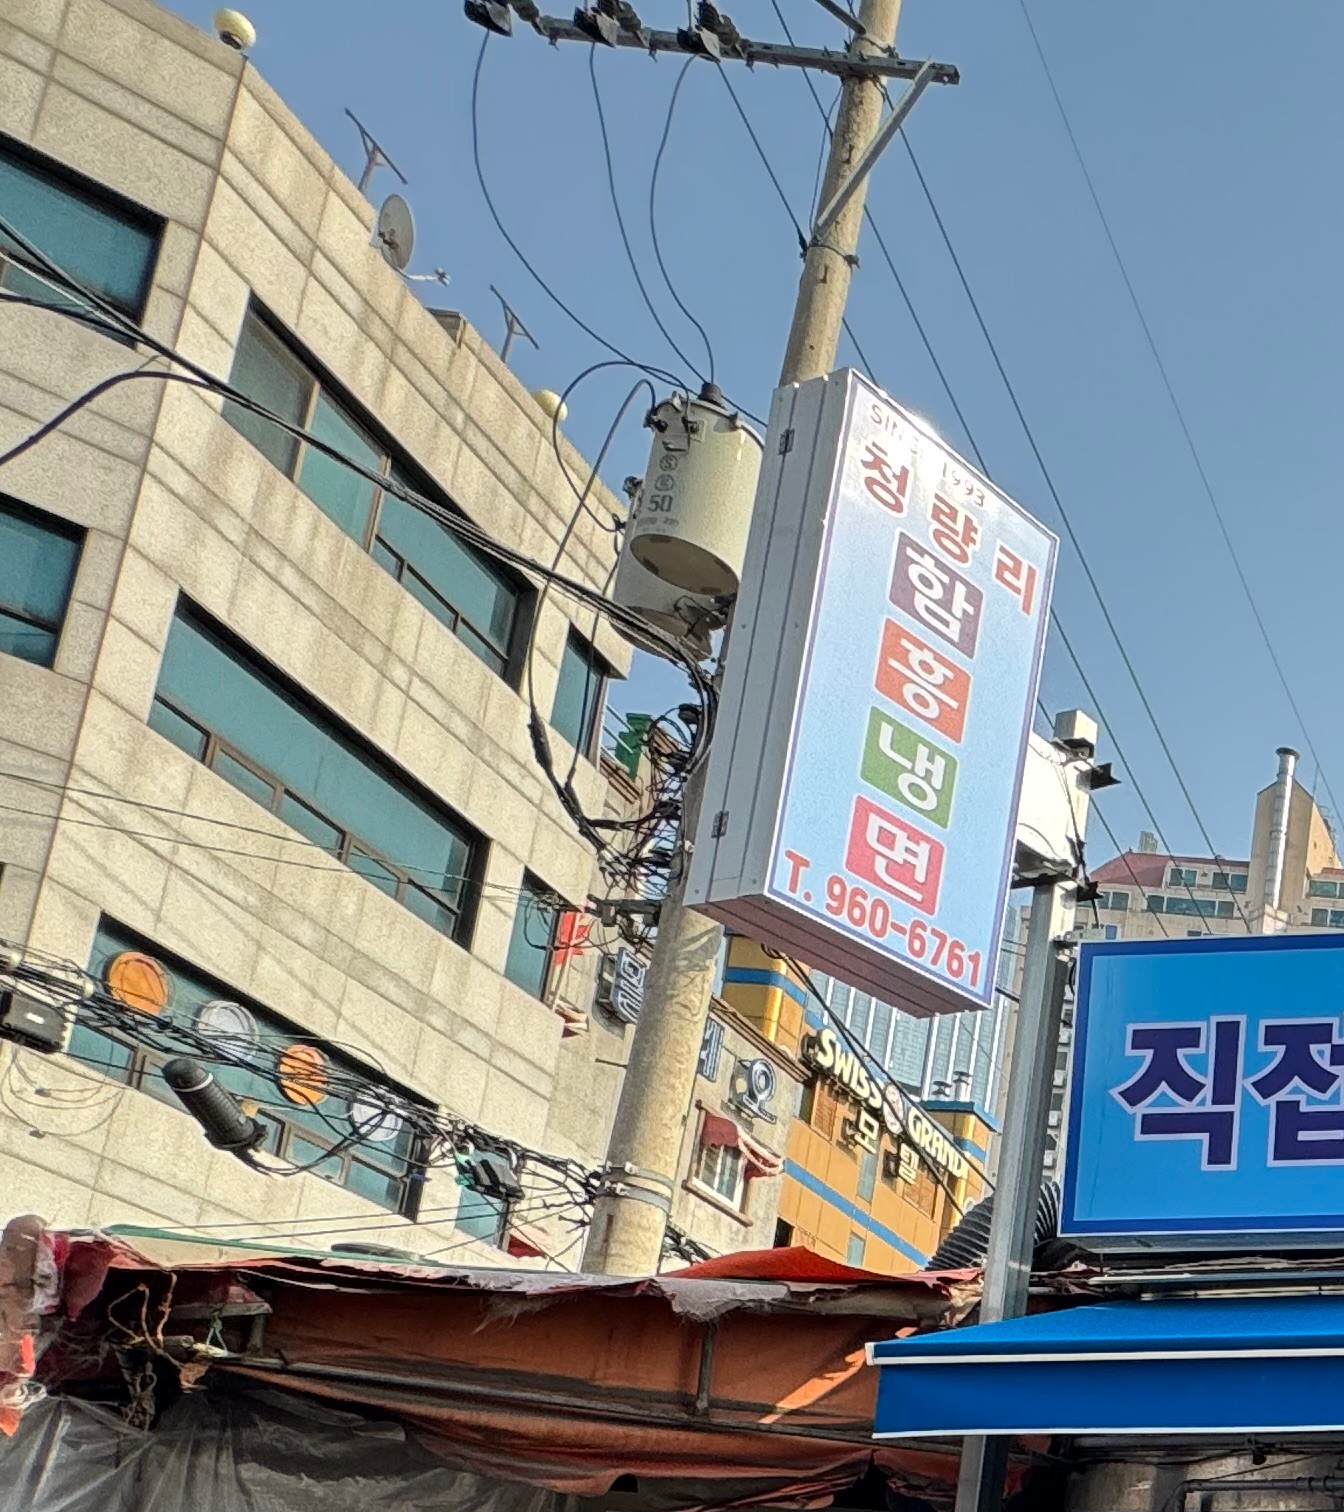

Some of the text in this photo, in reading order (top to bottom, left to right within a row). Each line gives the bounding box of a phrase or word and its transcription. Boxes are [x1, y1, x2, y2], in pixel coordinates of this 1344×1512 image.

[648, 495, 673, 512] 50
[860, 441, 1037, 615] 청량리
[942, 461, 986, 507] 1993
[865, 546, 977, 902] 함흥냉면
[784, 849, 982, 988] T. 960-6761
[816, 1029, 882, 1109] SWISS
[908, 1106, 969, 1179] GRAND
